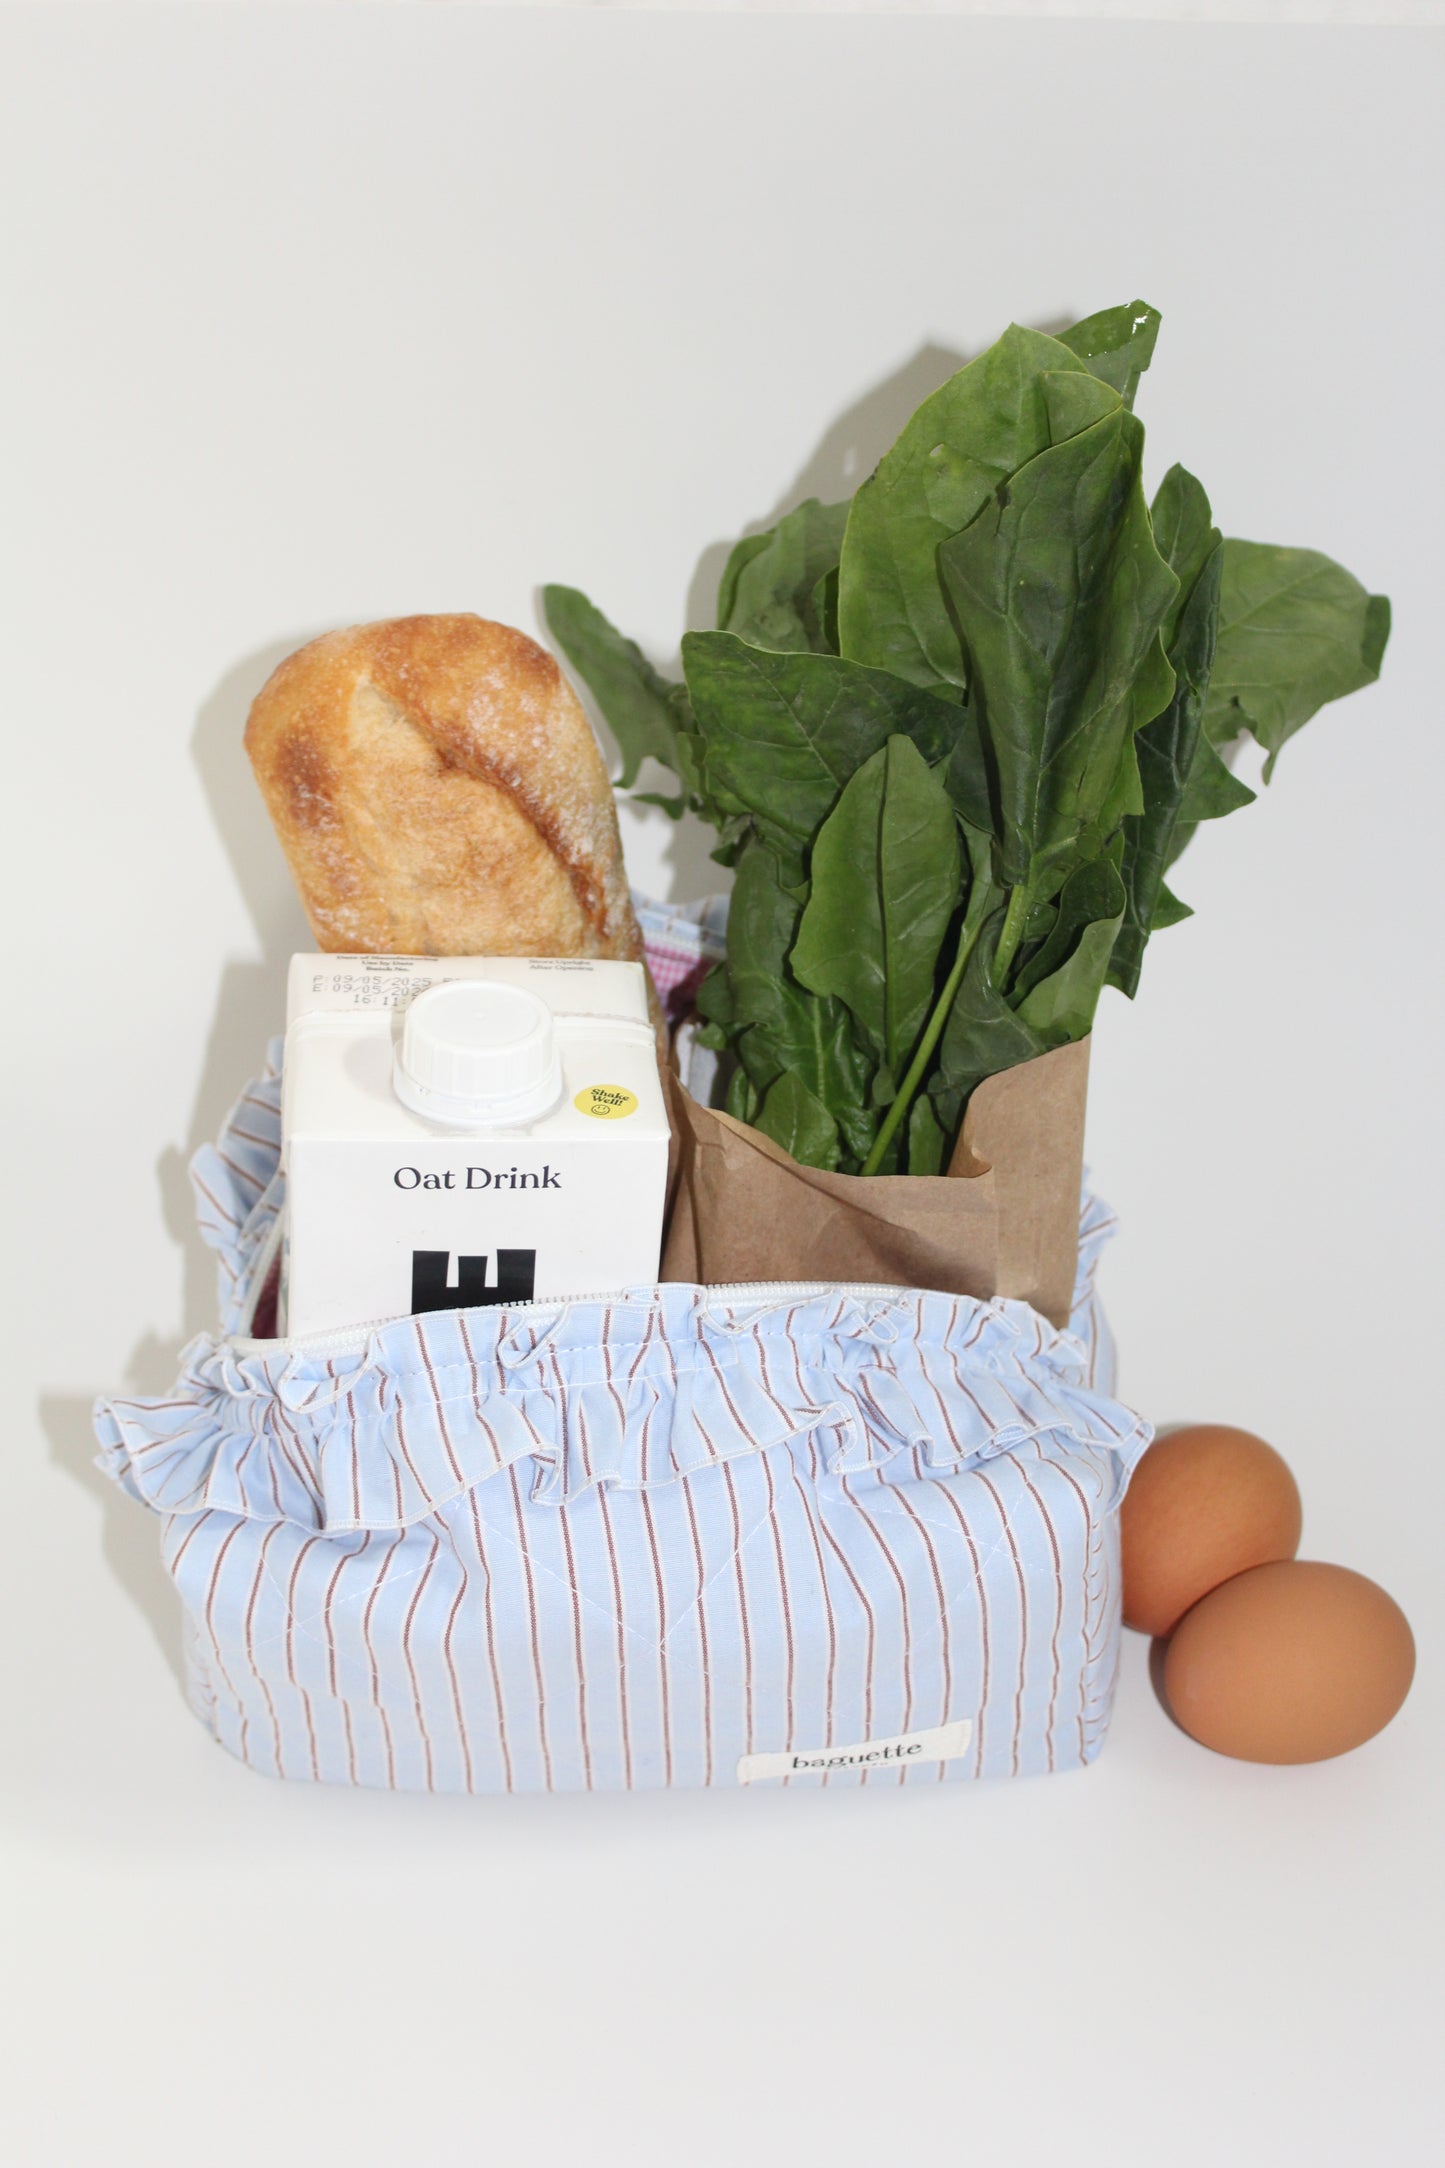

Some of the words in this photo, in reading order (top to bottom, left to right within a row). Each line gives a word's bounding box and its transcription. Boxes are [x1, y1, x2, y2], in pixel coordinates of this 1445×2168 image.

[590, 1088, 630, 1101] Shake
[592, 1095, 623, 1106] Well!
[393, 1166, 456, 1190] Oat
[465, 1165, 562, 1190] Drink
[792, 1743, 923, 1769] baguette
